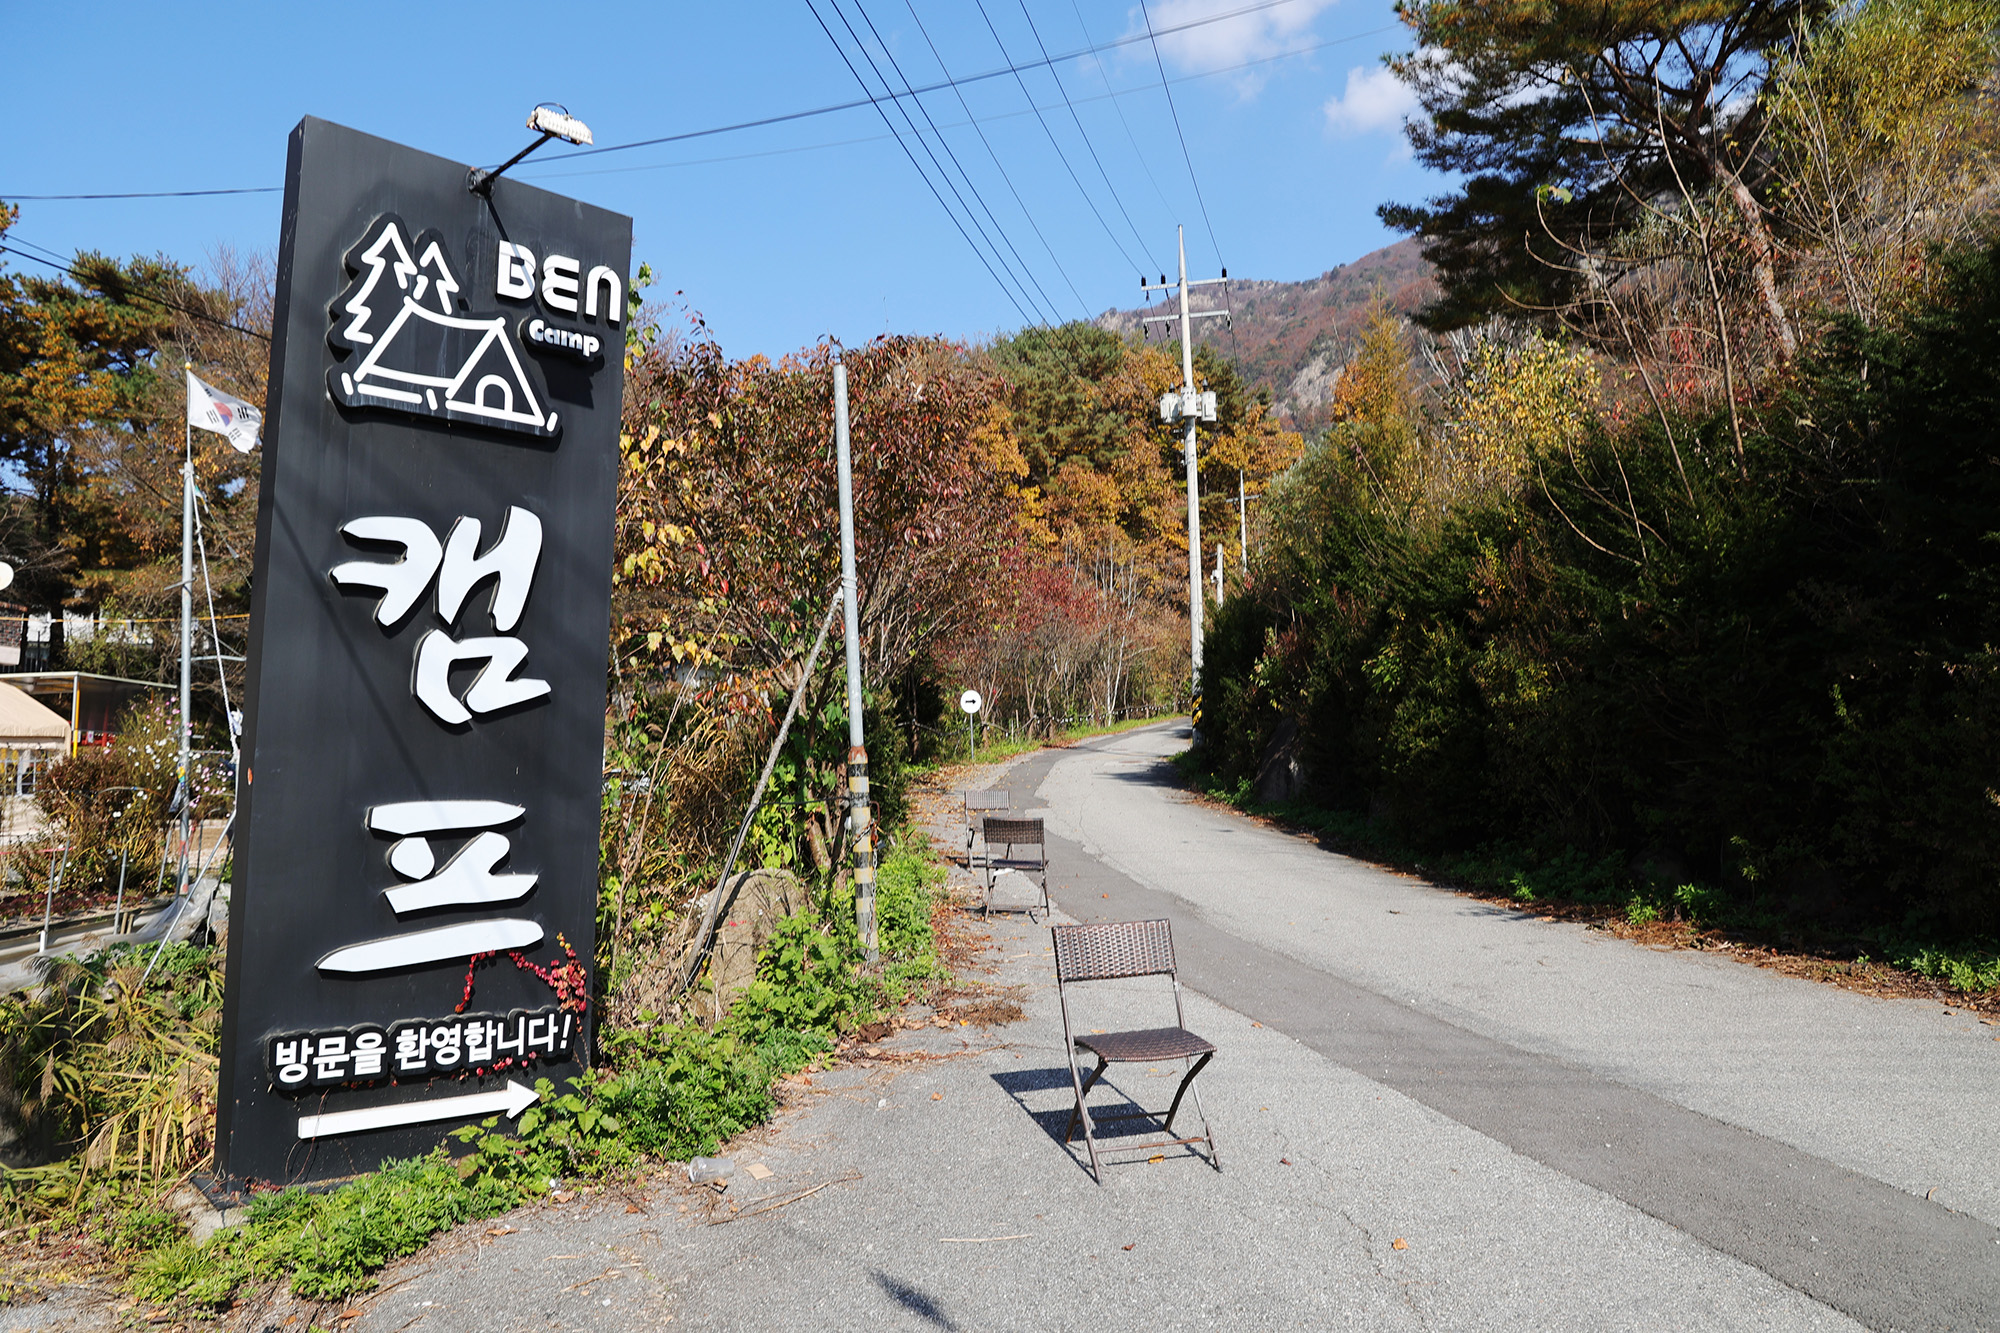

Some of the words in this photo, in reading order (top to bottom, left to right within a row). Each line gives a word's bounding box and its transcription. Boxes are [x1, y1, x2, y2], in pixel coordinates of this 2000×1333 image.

[316, 506, 551, 972] 캠프
[275, 1032, 386, 1083] 방문을
[395, 1014, 571, 1070] 환영합니다!
